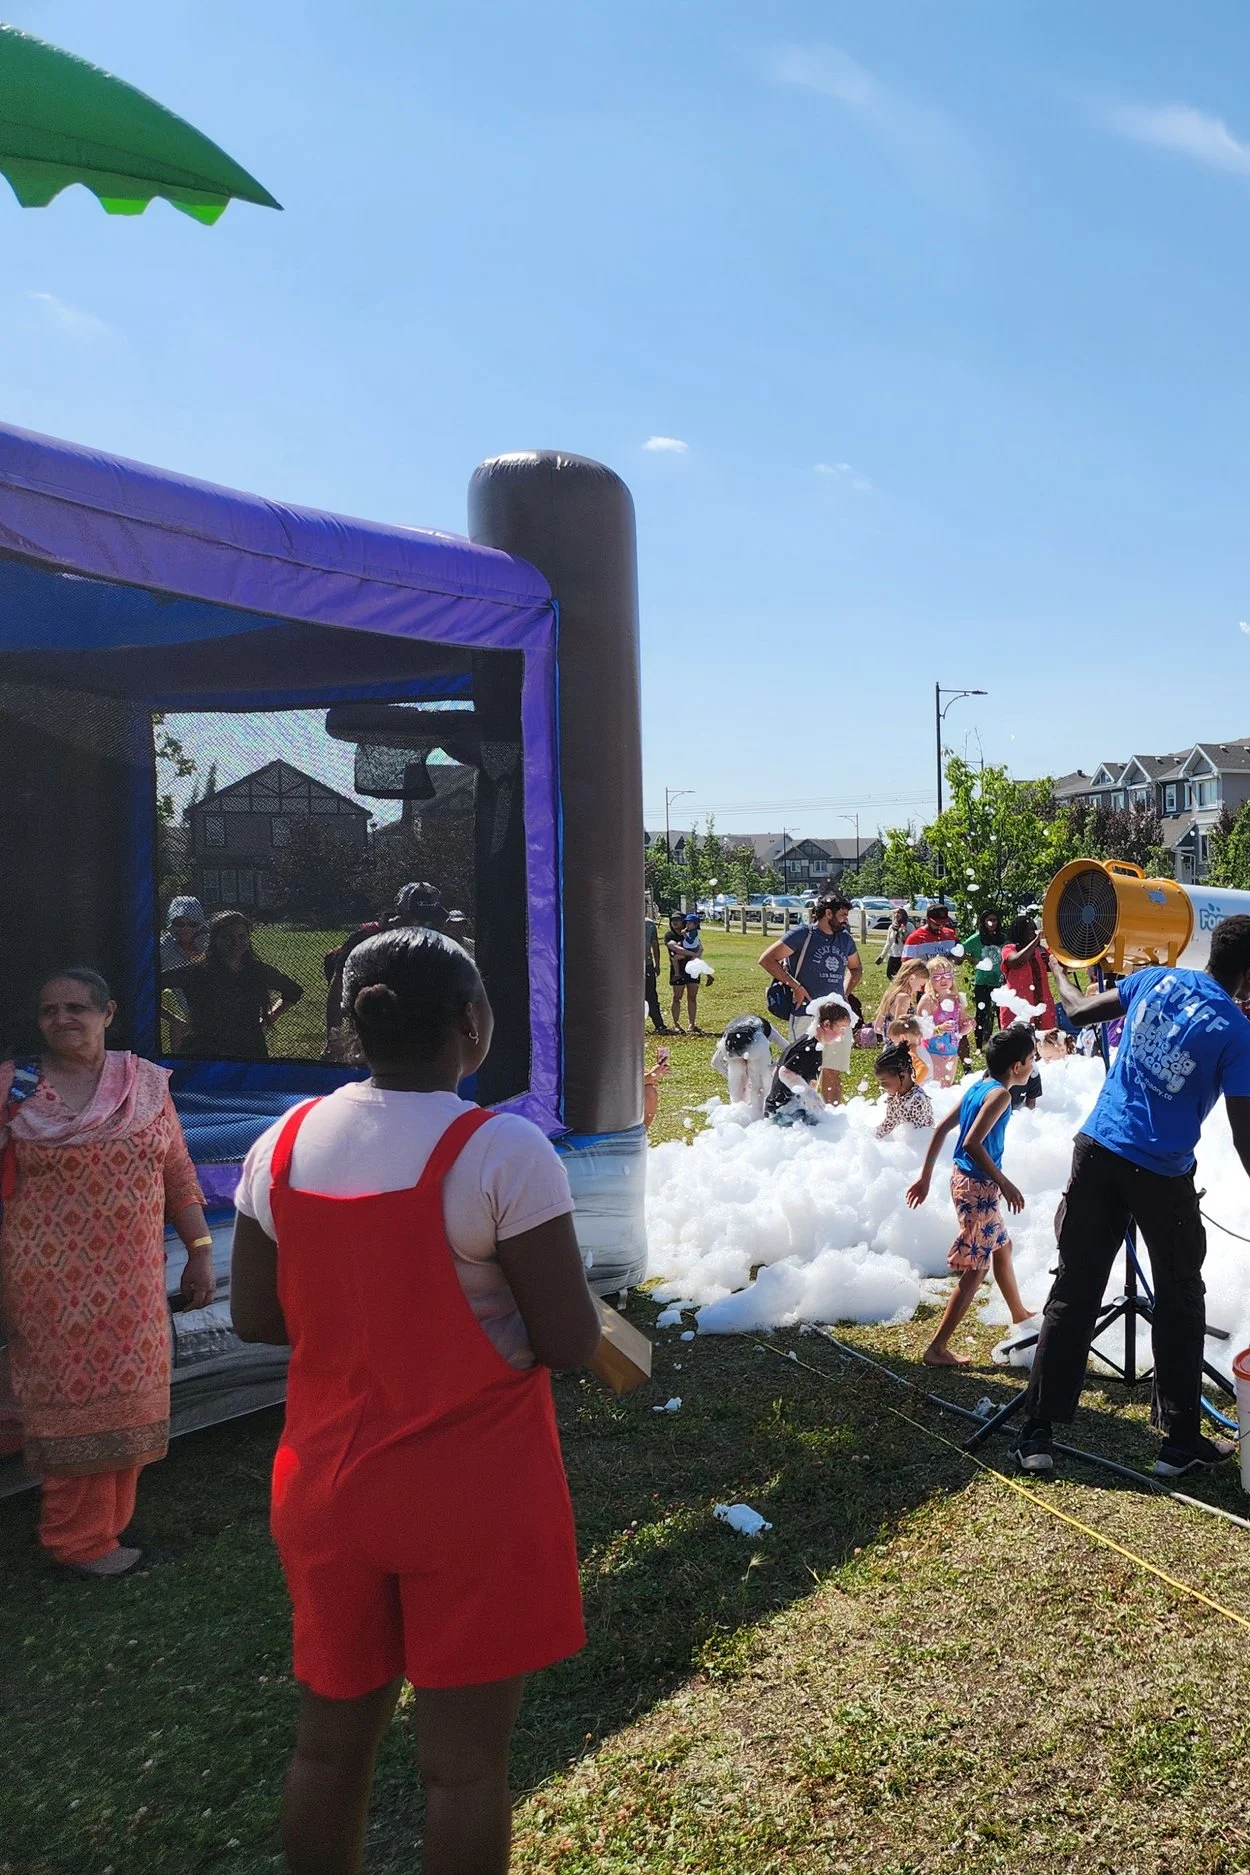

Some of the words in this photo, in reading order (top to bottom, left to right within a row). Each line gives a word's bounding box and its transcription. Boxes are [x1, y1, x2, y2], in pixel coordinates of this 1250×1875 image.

[812, 945, 830, 964] LUCKY
[1154, 975, 1230, 1033] STAFF
[1132, 1031, 1183, 1075] ounce
[1167, 1044, 1197, 1076] big
